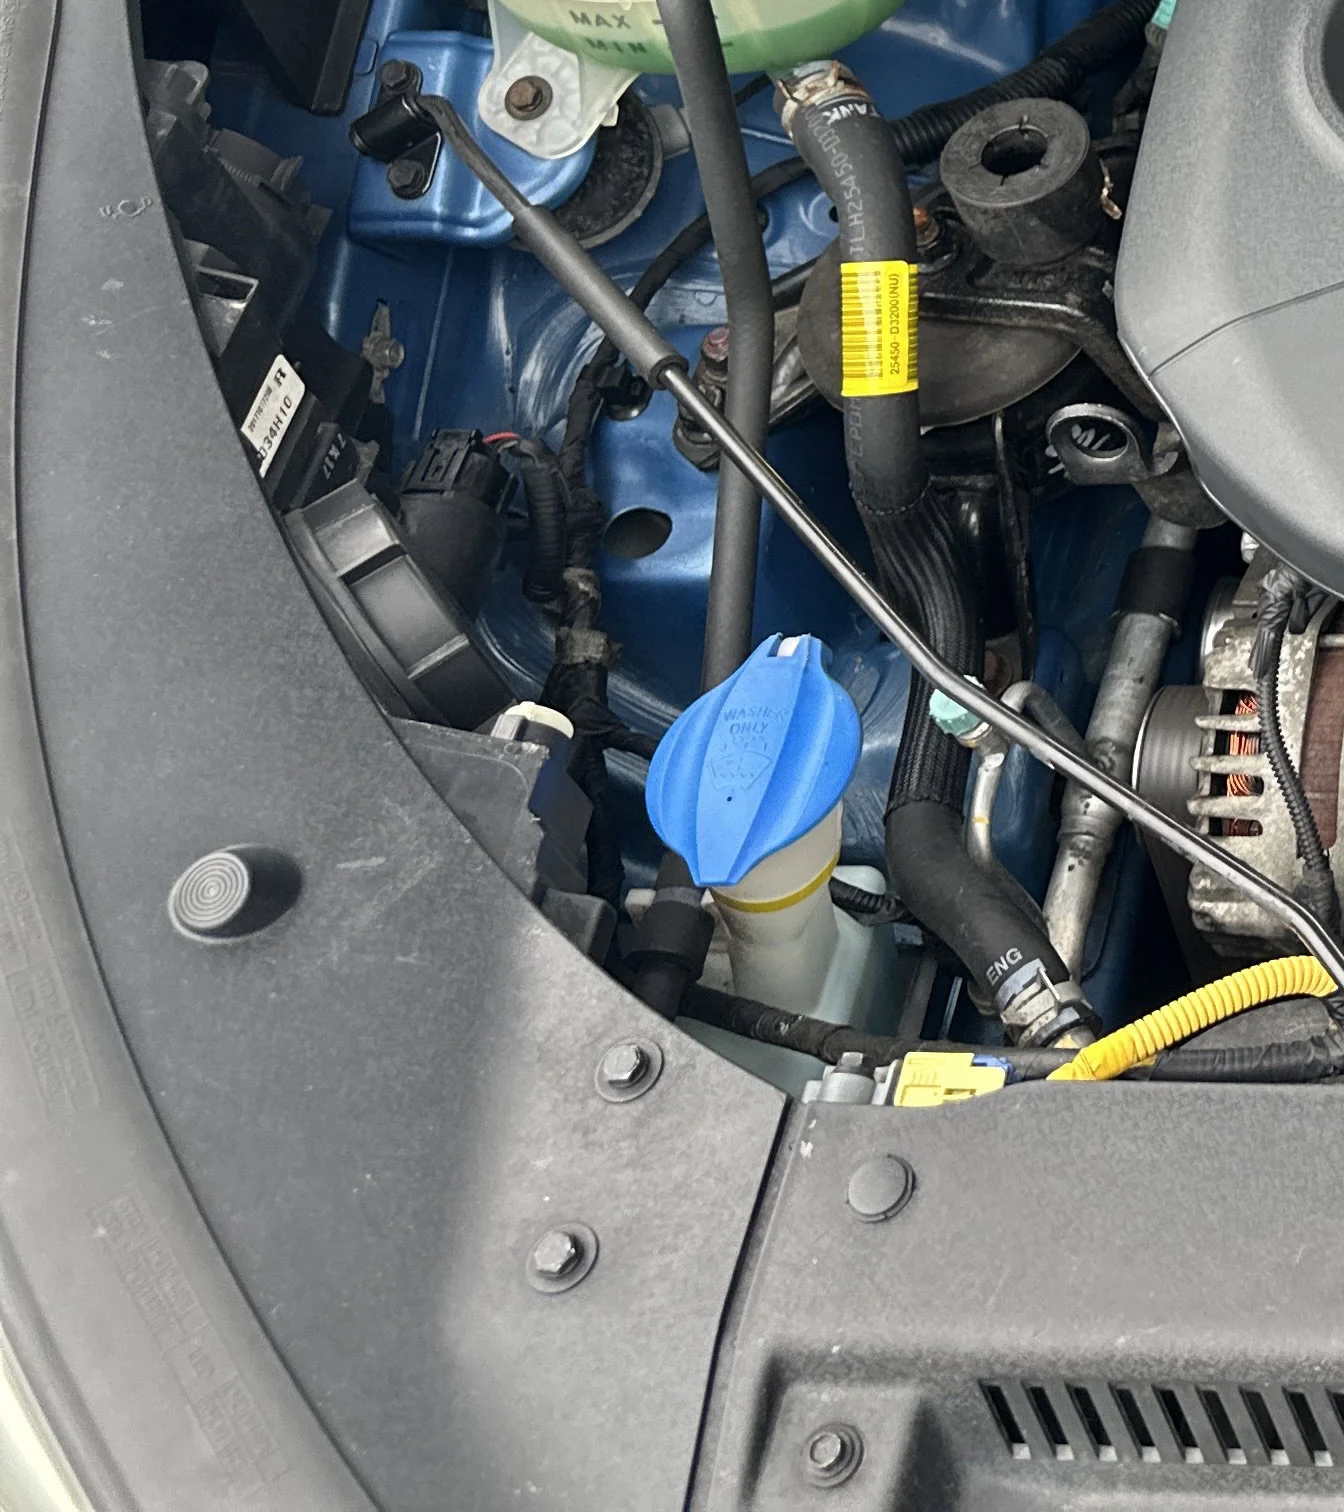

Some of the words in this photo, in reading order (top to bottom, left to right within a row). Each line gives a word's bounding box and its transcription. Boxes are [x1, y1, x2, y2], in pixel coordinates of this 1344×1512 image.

[569, 10, 632, 30] MAX
[584, 37, 649, 55] MIN
[822, 102, 881, 126] TANK
[889, 272, 901, 377] 25450-D3200(NU)
[273, 367, 287, 388] R
[724, 706, 788, 722] WASHER
[729, 723, 768, 735] ONLY
[986, 948, 1023, 986] ENG
